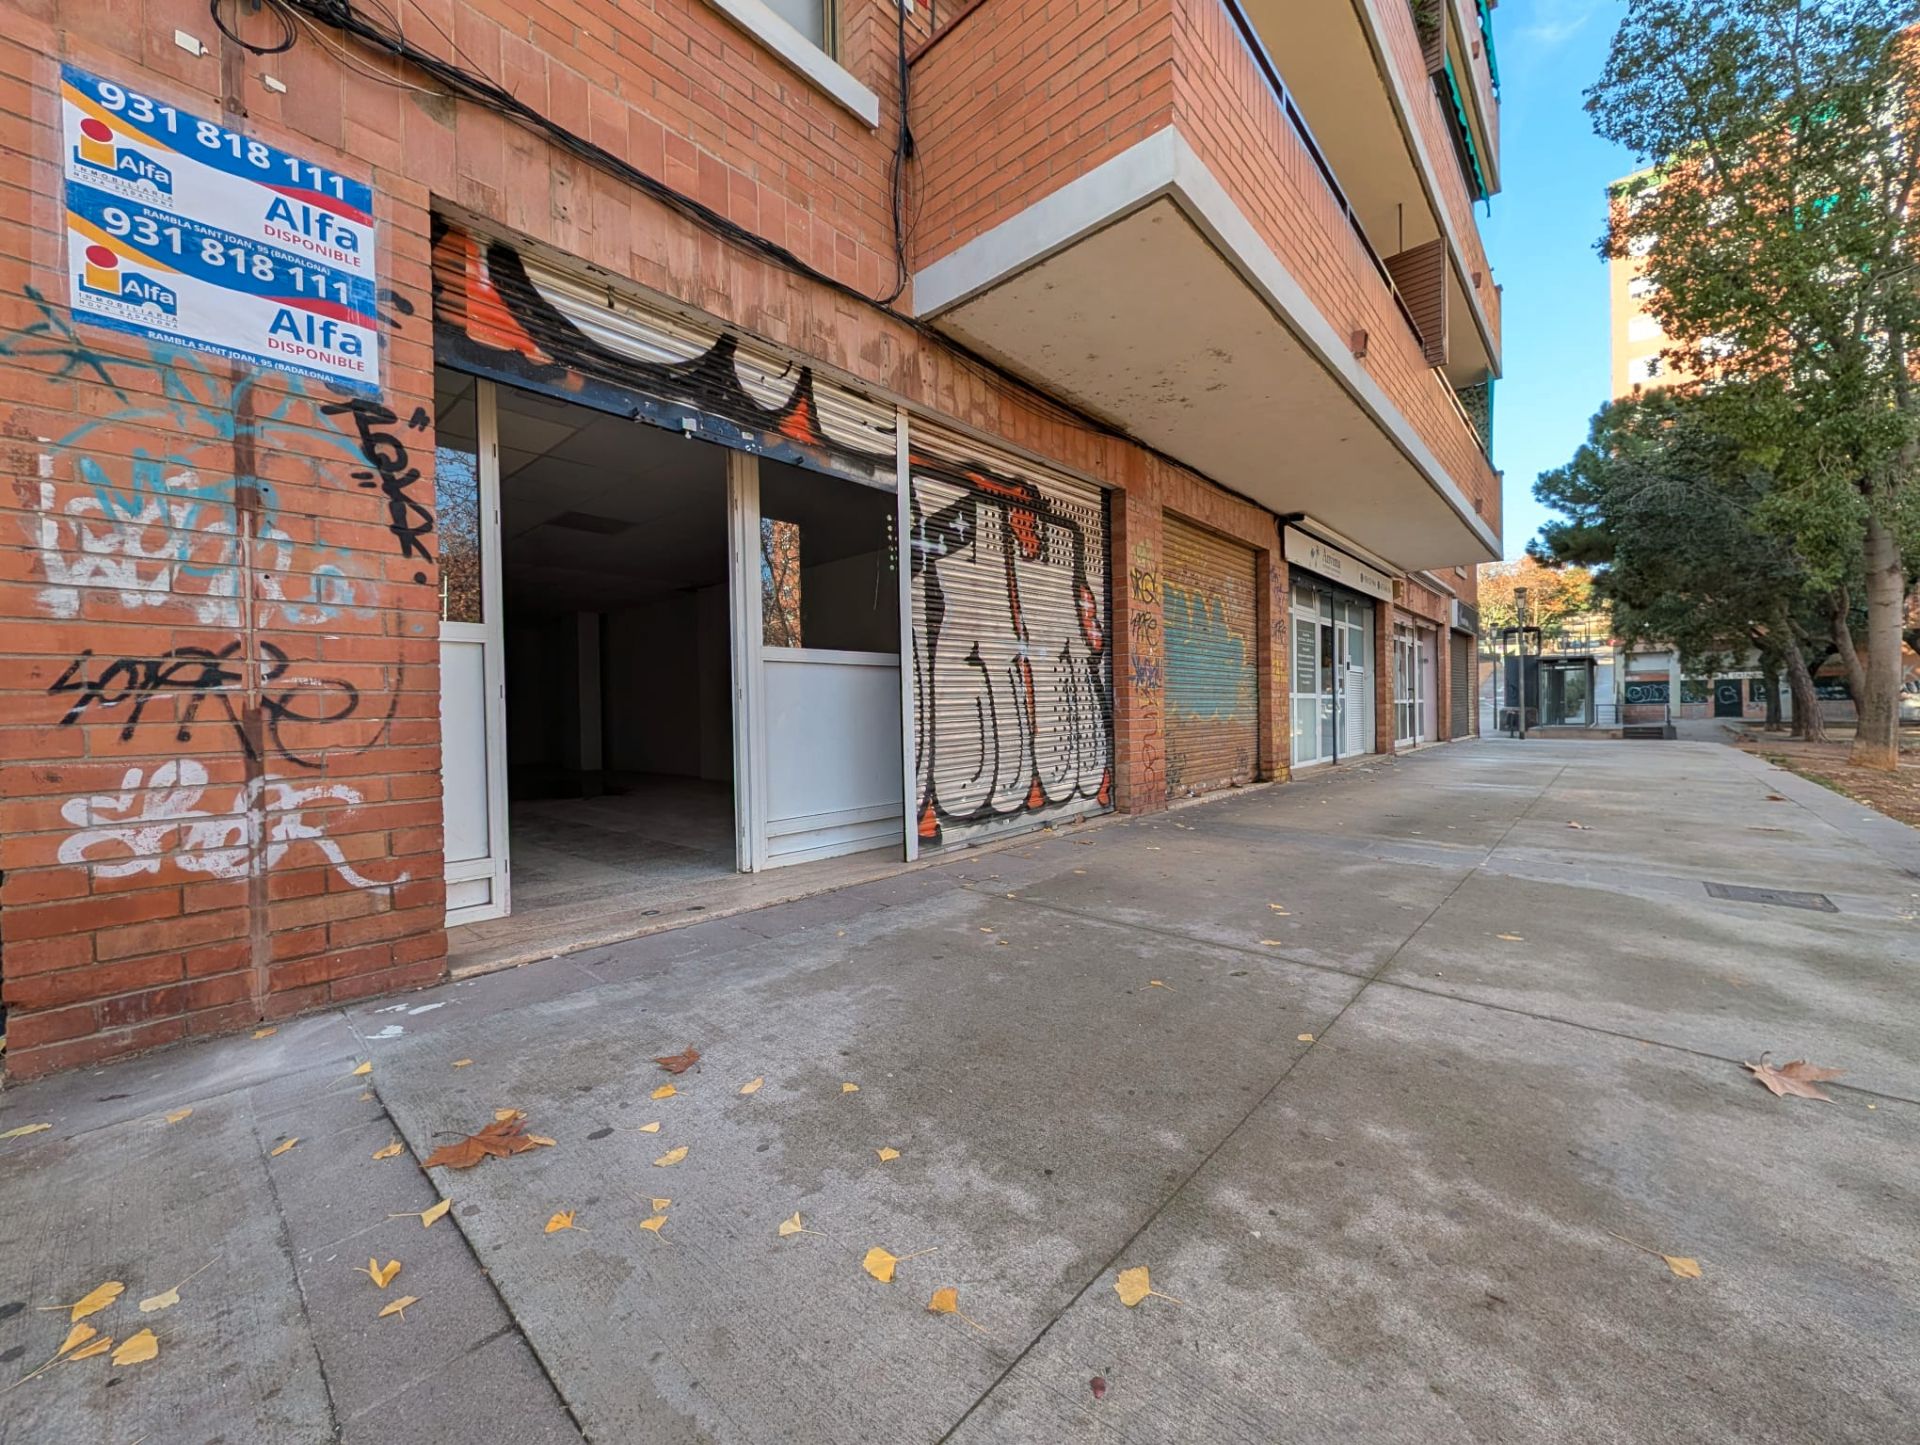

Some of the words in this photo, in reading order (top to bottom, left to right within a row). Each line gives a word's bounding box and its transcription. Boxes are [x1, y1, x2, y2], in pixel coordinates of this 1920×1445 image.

[97, 82, 177, 134] 931
[196, 120, 270, 169] 818
[284, 158, 344, 200] 111
[120, 156, 170, 184] Alfa
[143, 208, 192, 230] RAMBLA
[193, 224, 223, 239] SANT
[223, 234, 254, 251] JOAN,
[271, 248, 331, 276] (BADALONA)
[264, 224, 361, 267] DISPONIBLE
[265, 196, 359, 253] Alfa
[103, 207, 181, 255] 931
[201, 238, 275, 281] 818
[288, 266, 348, 305] 111
[124, 280, 175, 305] Alfa
[148, 330, 197, 349] RAMBLA
[198, 342, 227, 357] SANT
[228, 350, 259, 366] JOAN,
[274, 362, 335, 385] (BADALONA)
[268, 308, 362, 357] Alfa
[268, 337, 365, 372] DISPONIBLE
